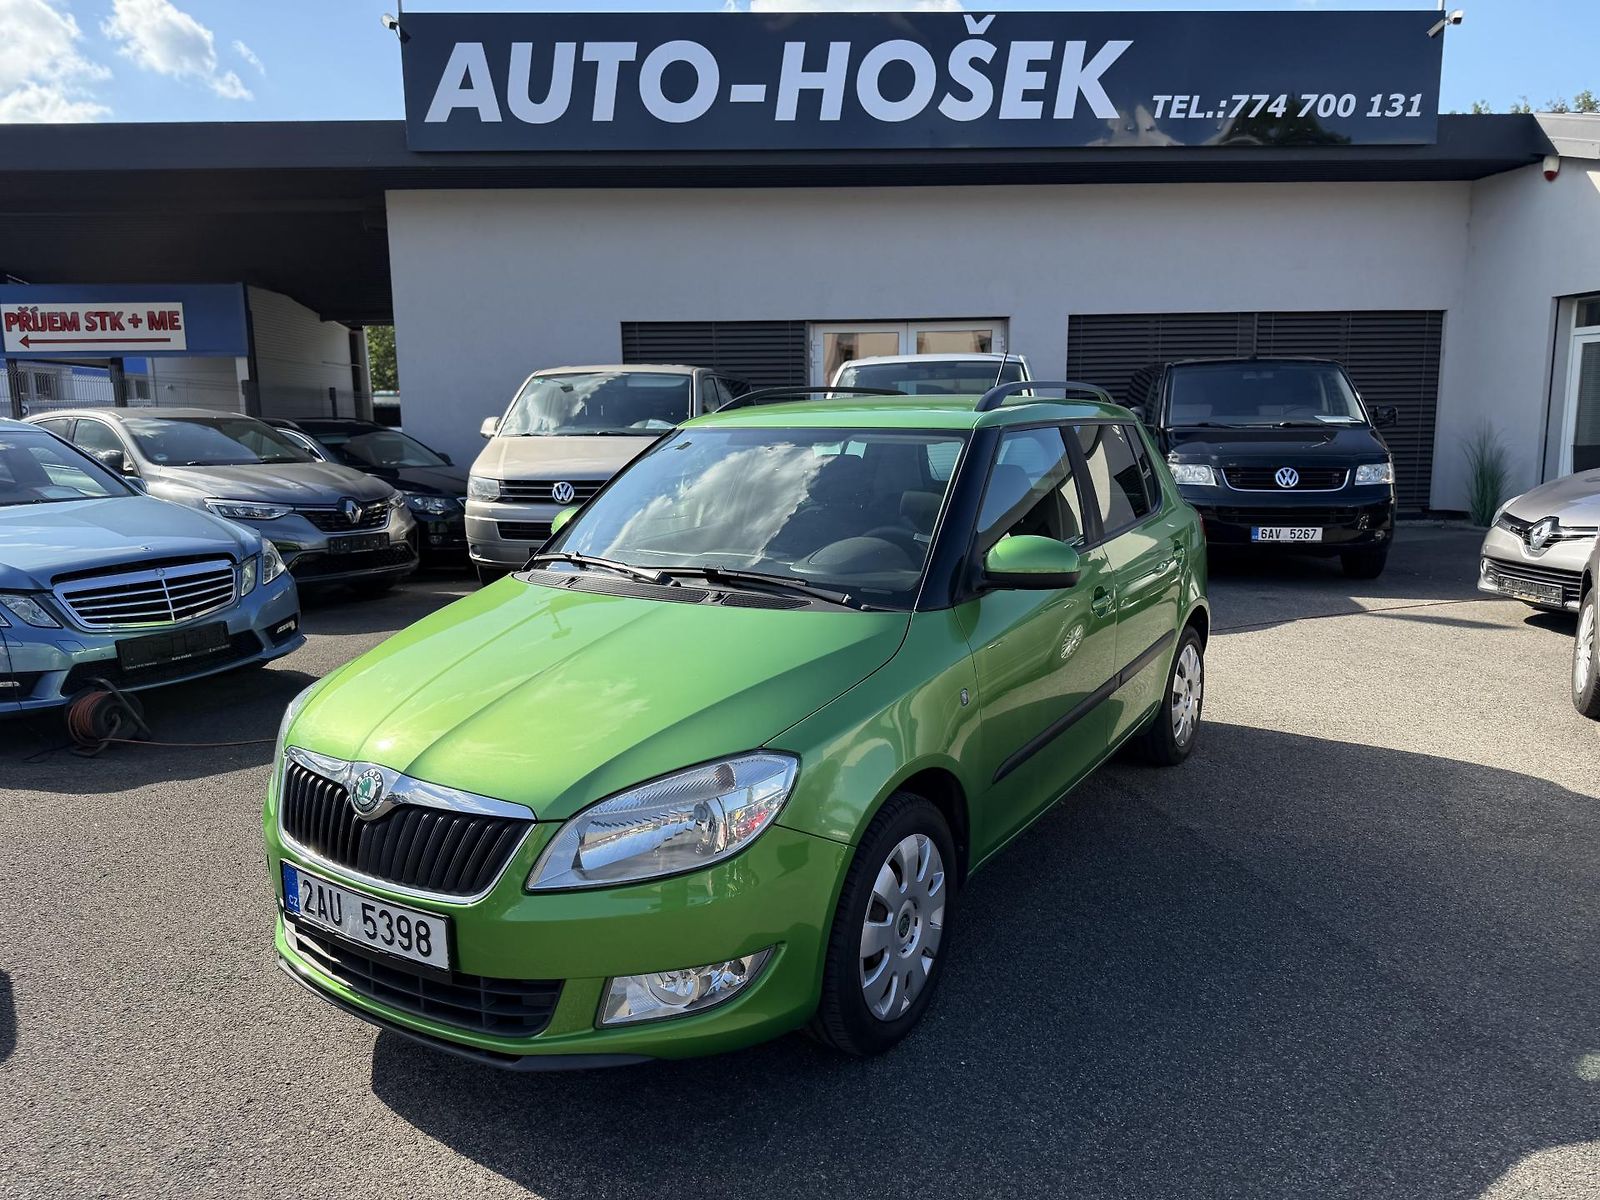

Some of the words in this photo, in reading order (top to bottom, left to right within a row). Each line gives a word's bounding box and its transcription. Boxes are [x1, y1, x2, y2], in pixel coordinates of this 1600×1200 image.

[424, 14, 1134, 124] AUTO-HOŠEK
[1152, 94, 1288, 119] TEL.:774
[1296, 94, 1356, 118] 700
[1366, 93, 1422, 118] 131
[4, 306, 81, 332] PŘÍJEM
[85, 311, 125, 332] STK
[147, 310, 182, 331] ME
[1261, 528, 1281, 540] 6AV
[1289, 528, 1317, 540] 5267
[302, 879, 343, 926] 2AU
[361, 902, 432, 957] 5398
